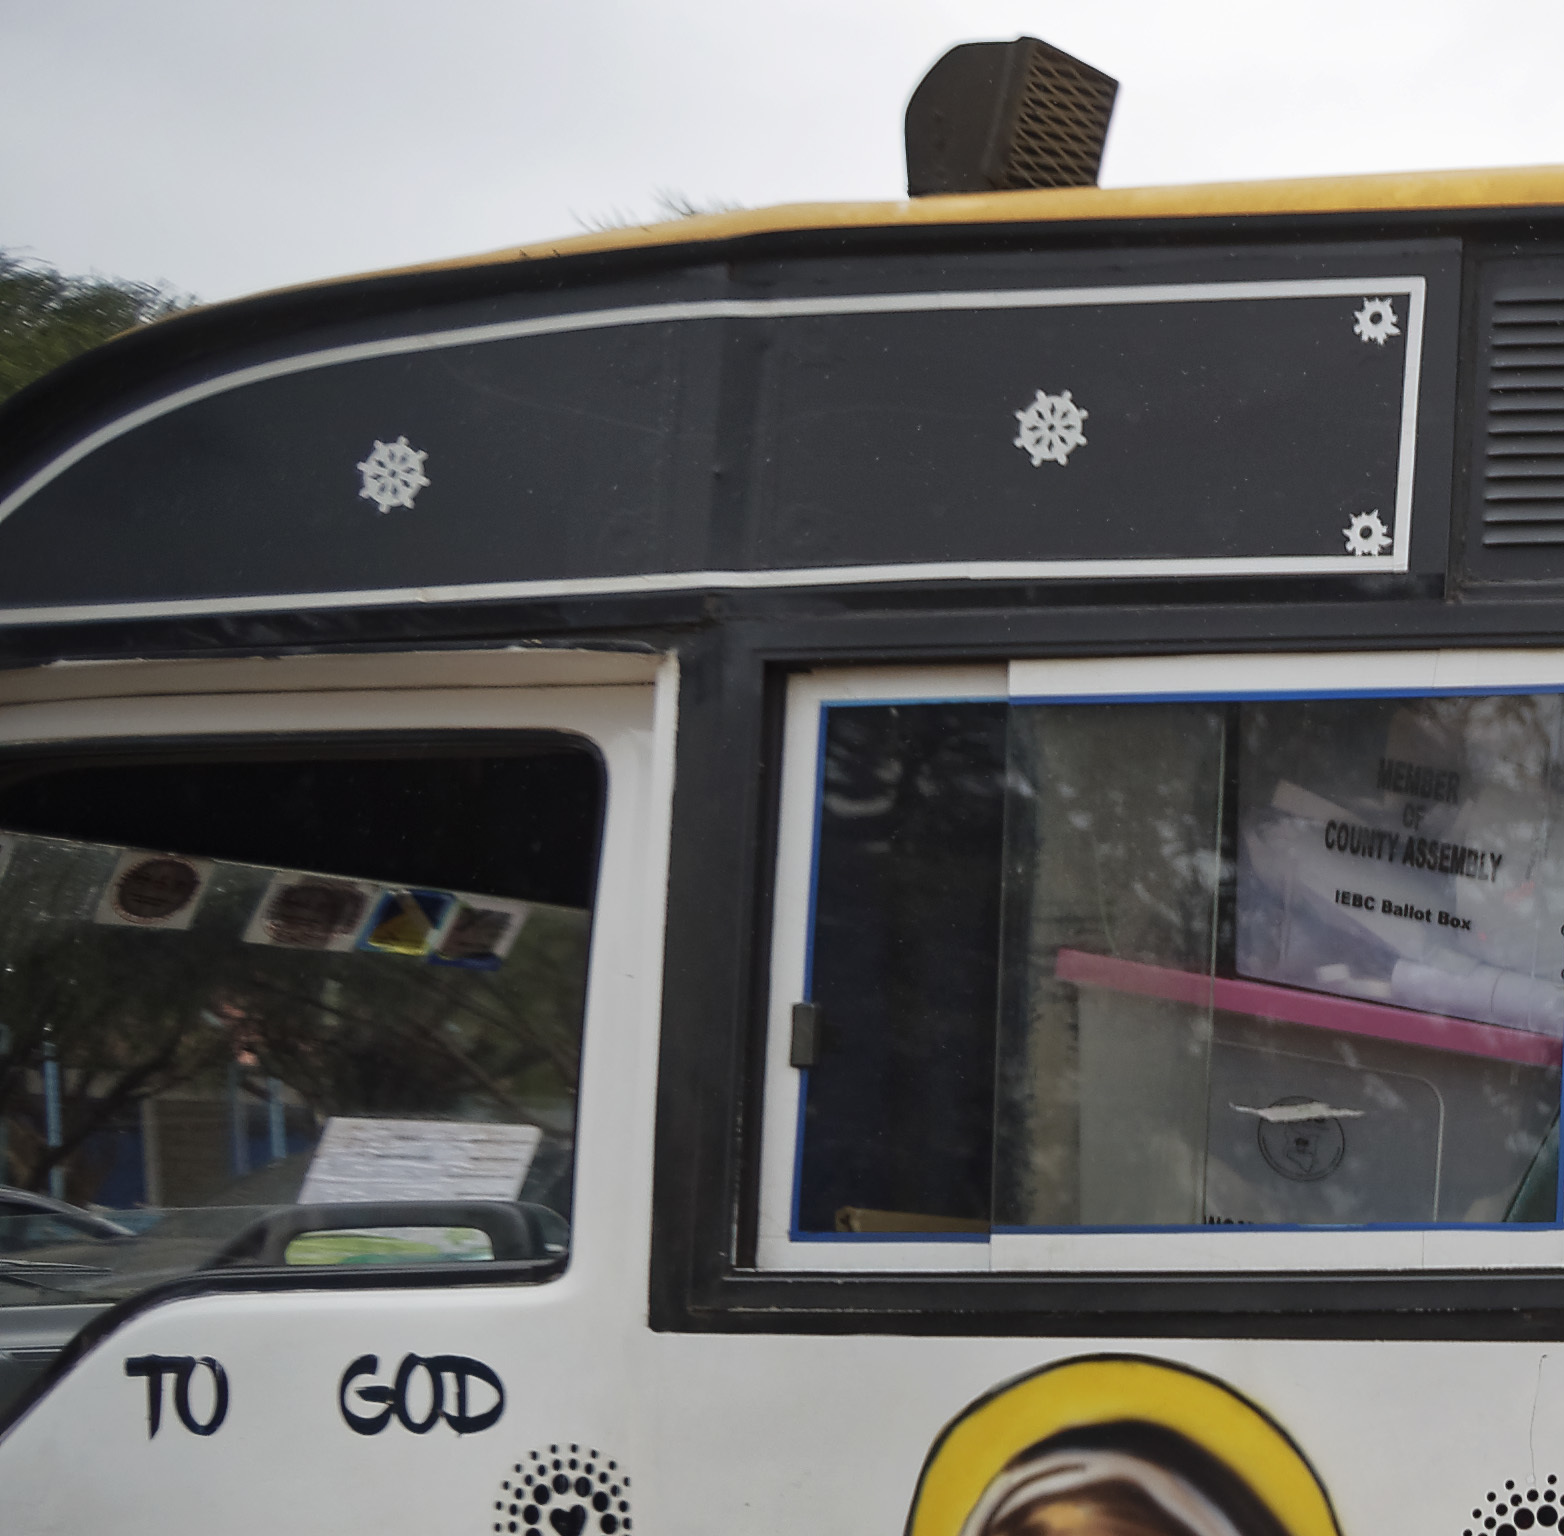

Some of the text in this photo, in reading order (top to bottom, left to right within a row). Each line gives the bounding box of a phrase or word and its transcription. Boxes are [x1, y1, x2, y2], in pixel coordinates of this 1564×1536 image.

[1377, 758, 1460, 803] MEMBER
[1402, 804, 1426, 830] OF
[1325, 820, 1503, 882] COUNTY ASSEMBLY
[1335, 889, 1471, 931] IEBC Ballot Box
[124, 1352, 505, 1439] TO GOD
